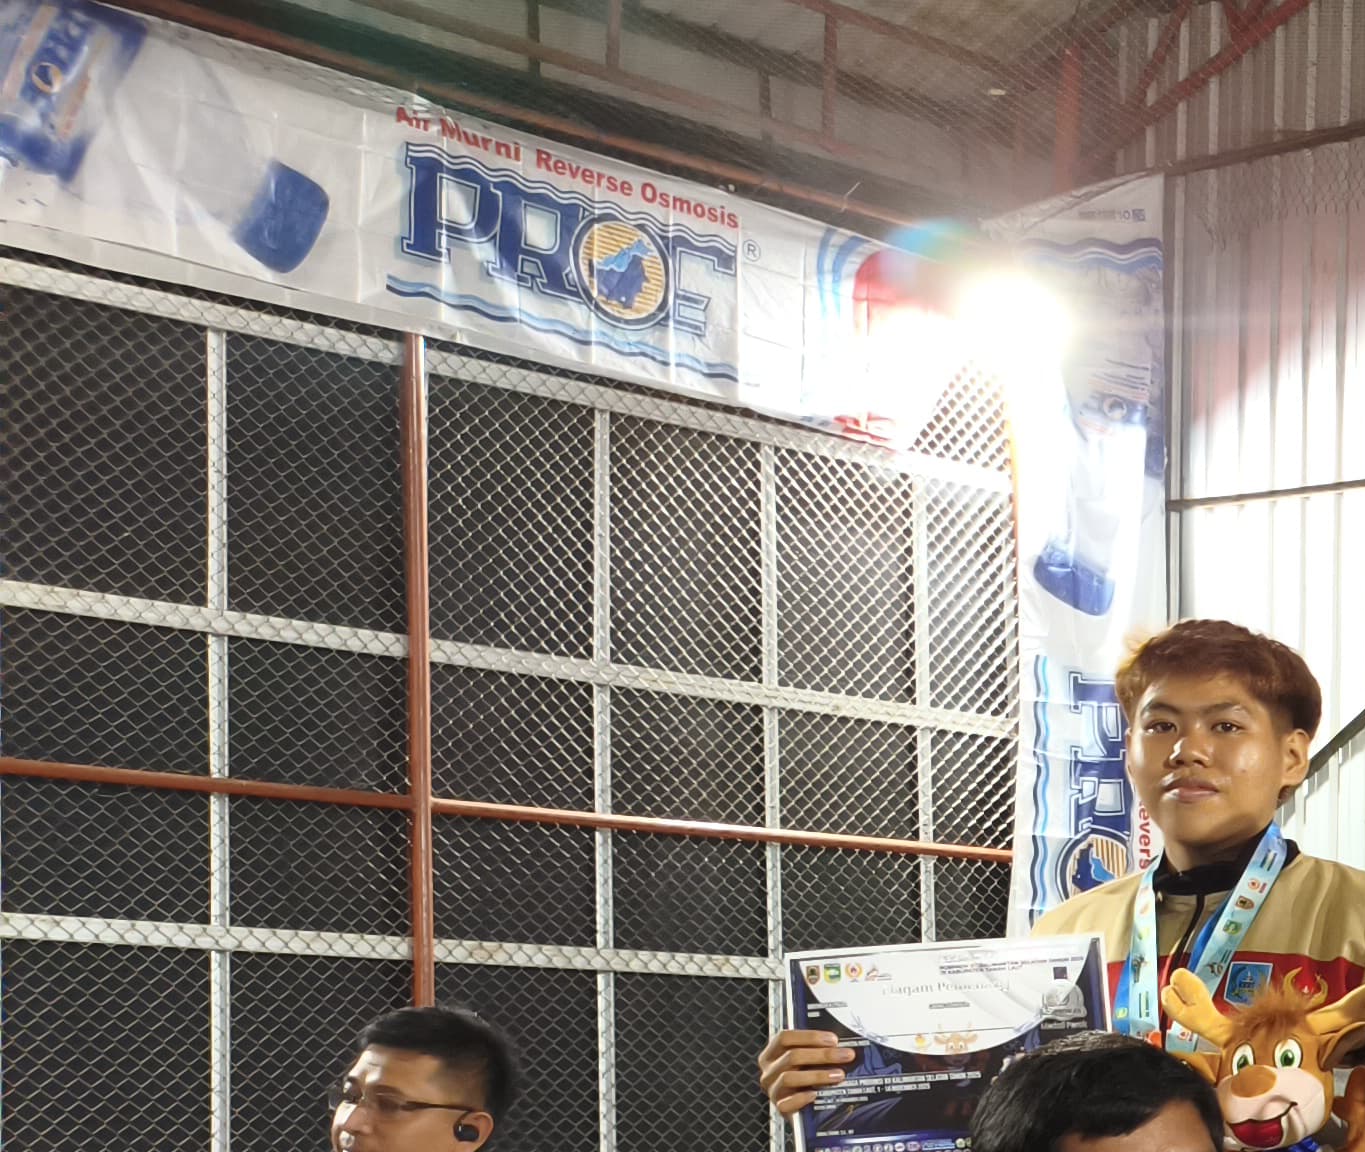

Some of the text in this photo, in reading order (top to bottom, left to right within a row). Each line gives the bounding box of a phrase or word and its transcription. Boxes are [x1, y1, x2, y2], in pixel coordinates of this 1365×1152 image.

[396, 107, 739, 228] Air Murni Reverse Osmosis
[1138, 801, 1152, 870] evers
